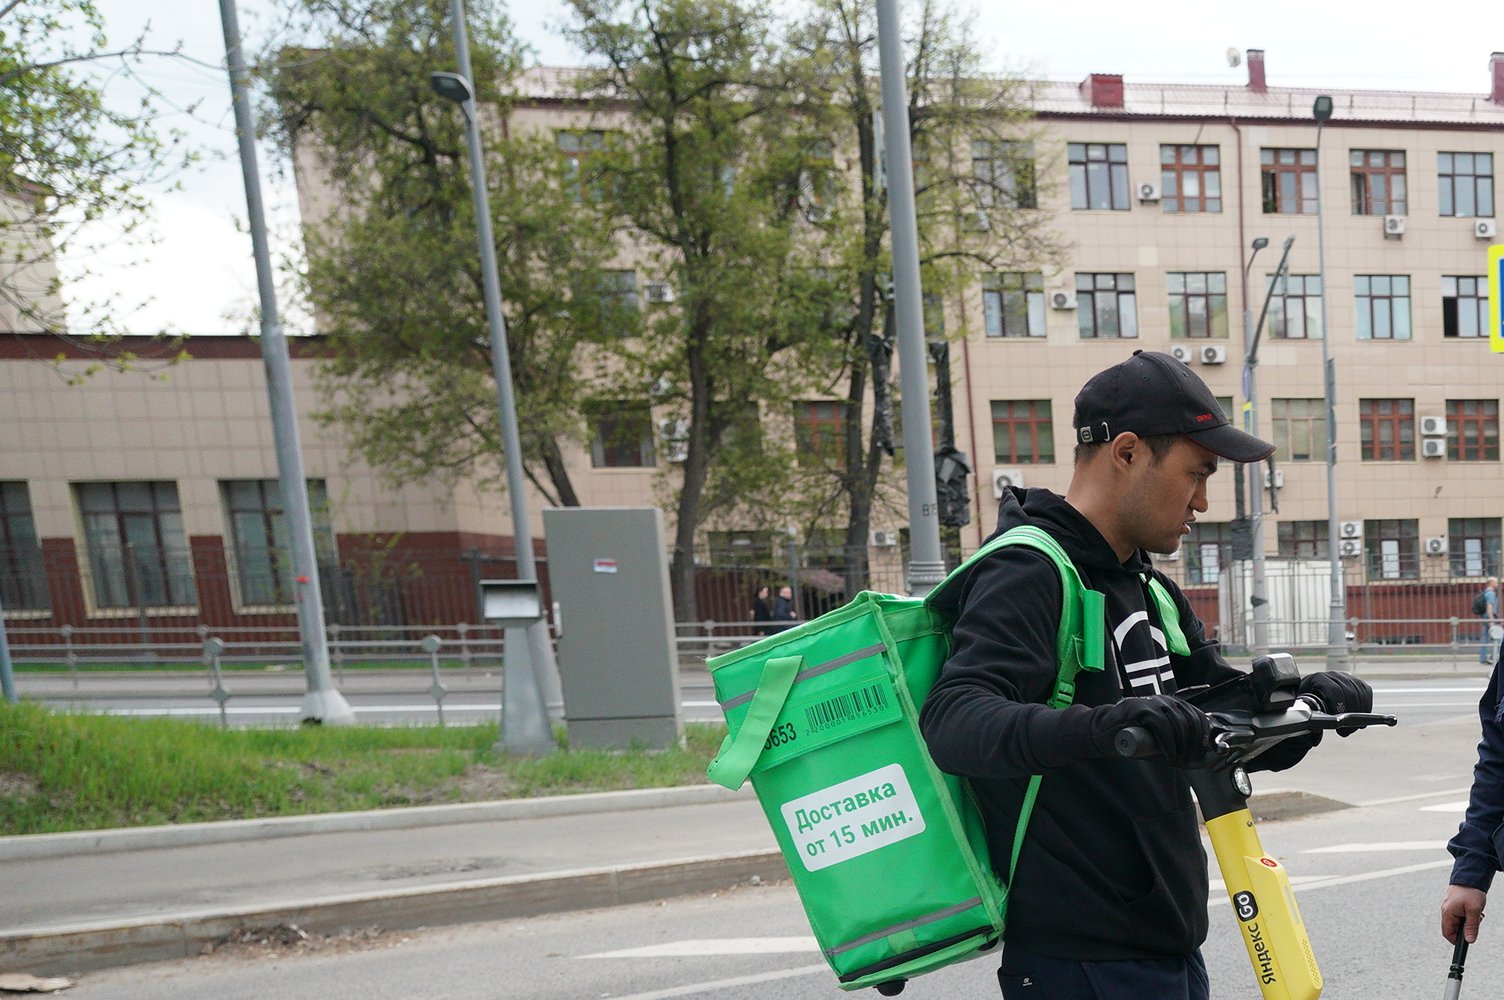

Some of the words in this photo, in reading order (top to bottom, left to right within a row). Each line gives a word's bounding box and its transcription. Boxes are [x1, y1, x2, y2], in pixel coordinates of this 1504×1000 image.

[794, 782, 897, 834] Доставка
[806, 839, 826, 857] от
[829, 824, 856, 848] 15
[860, 810, 914, 838] мин.
[1236, 893, 1256, 920] Go
[1247, 922, 1277, 985] Яндекс
